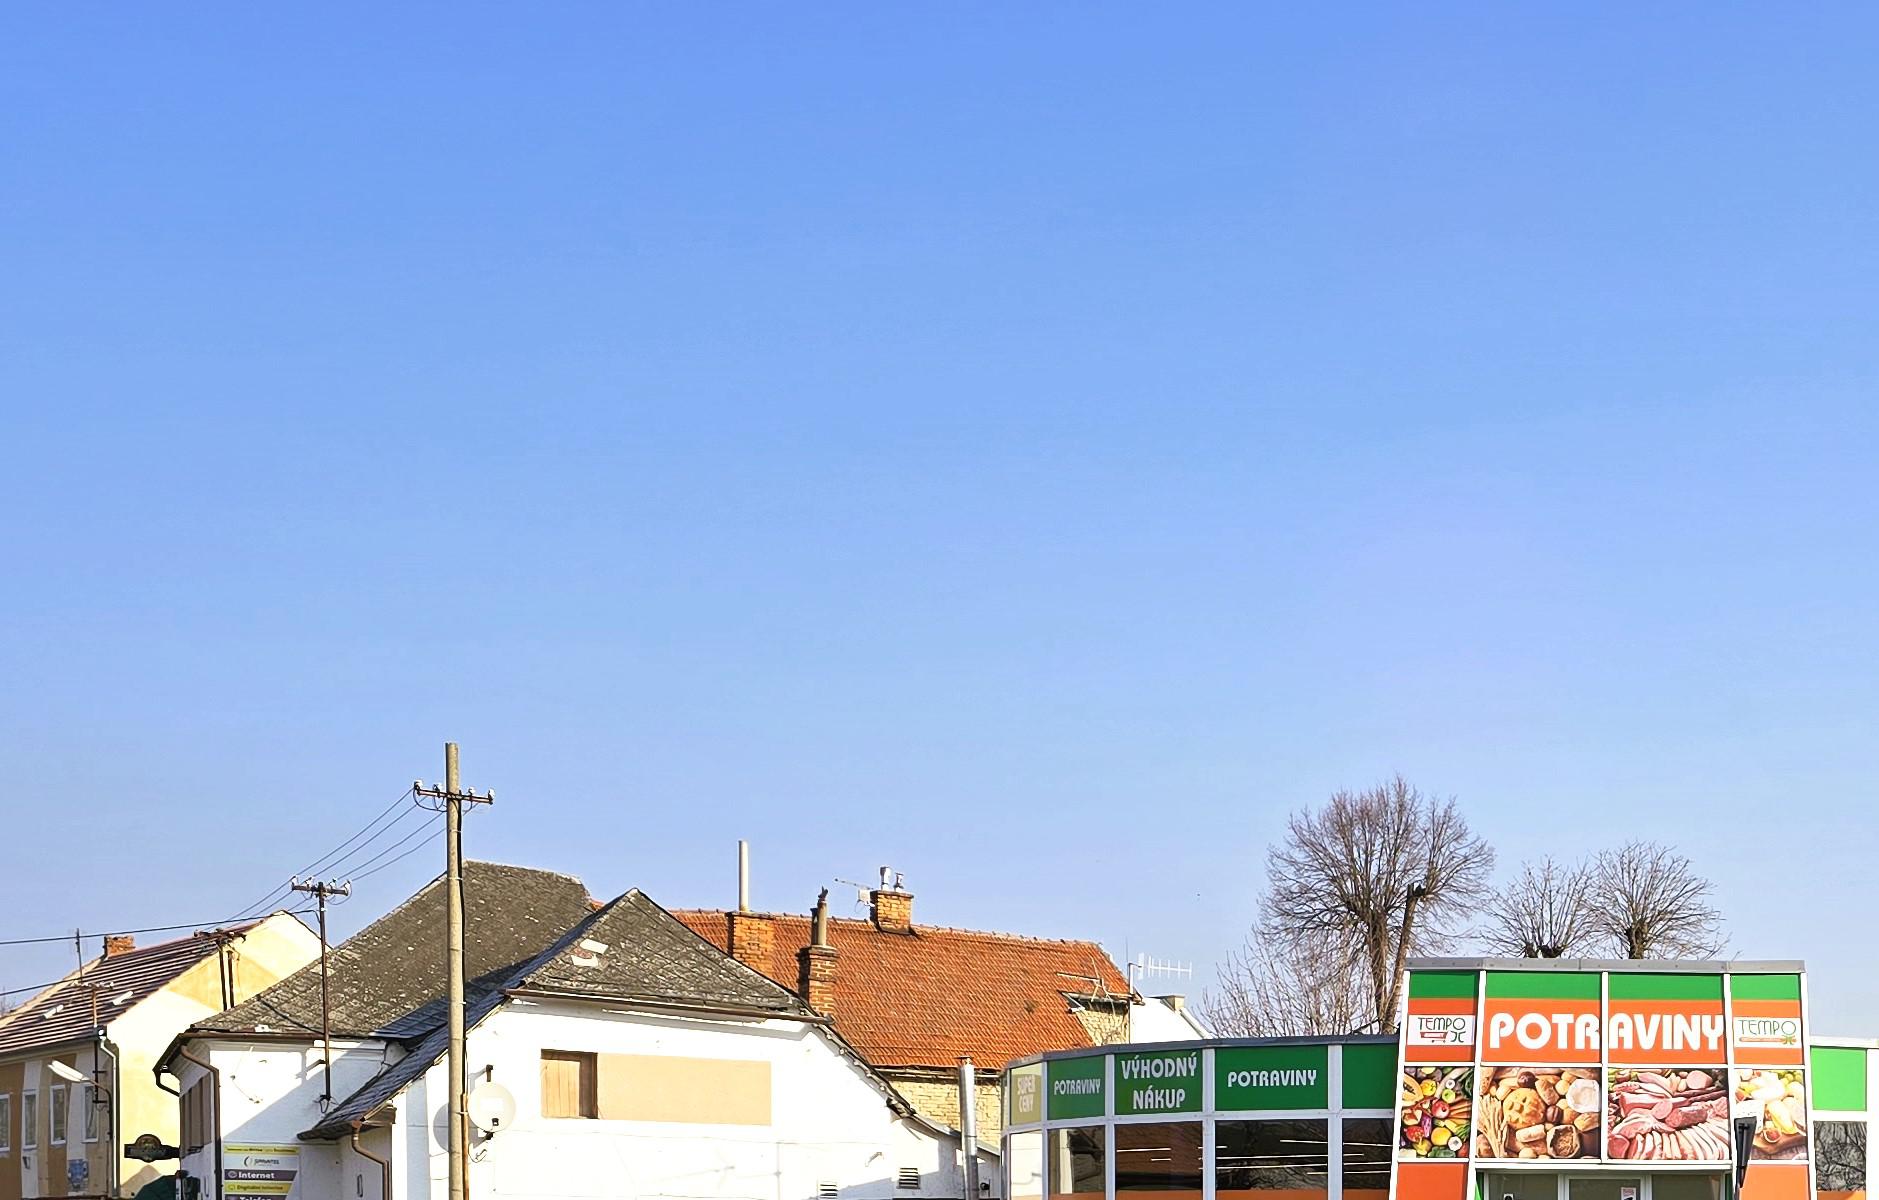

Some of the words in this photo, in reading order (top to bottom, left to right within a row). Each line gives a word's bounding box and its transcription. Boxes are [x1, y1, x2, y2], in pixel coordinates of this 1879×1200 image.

[1418, 1017, 1466, 1031] TEMPO
[1489, 1013, 1724, 1050] POTRAVINY
[1738, 1020, 1797, 1036] TEMPO
[1121, 1051, 1197, 1080] VÝHODNÝ
[1053, 1078, 1101, 1096] POTRAVINY
[1227, 1069, 1317, 1088] POTRAVINY
[1132, 1085, 1186, 1110] NÁKUP
[238, 1171, 275, 1179] Internet
